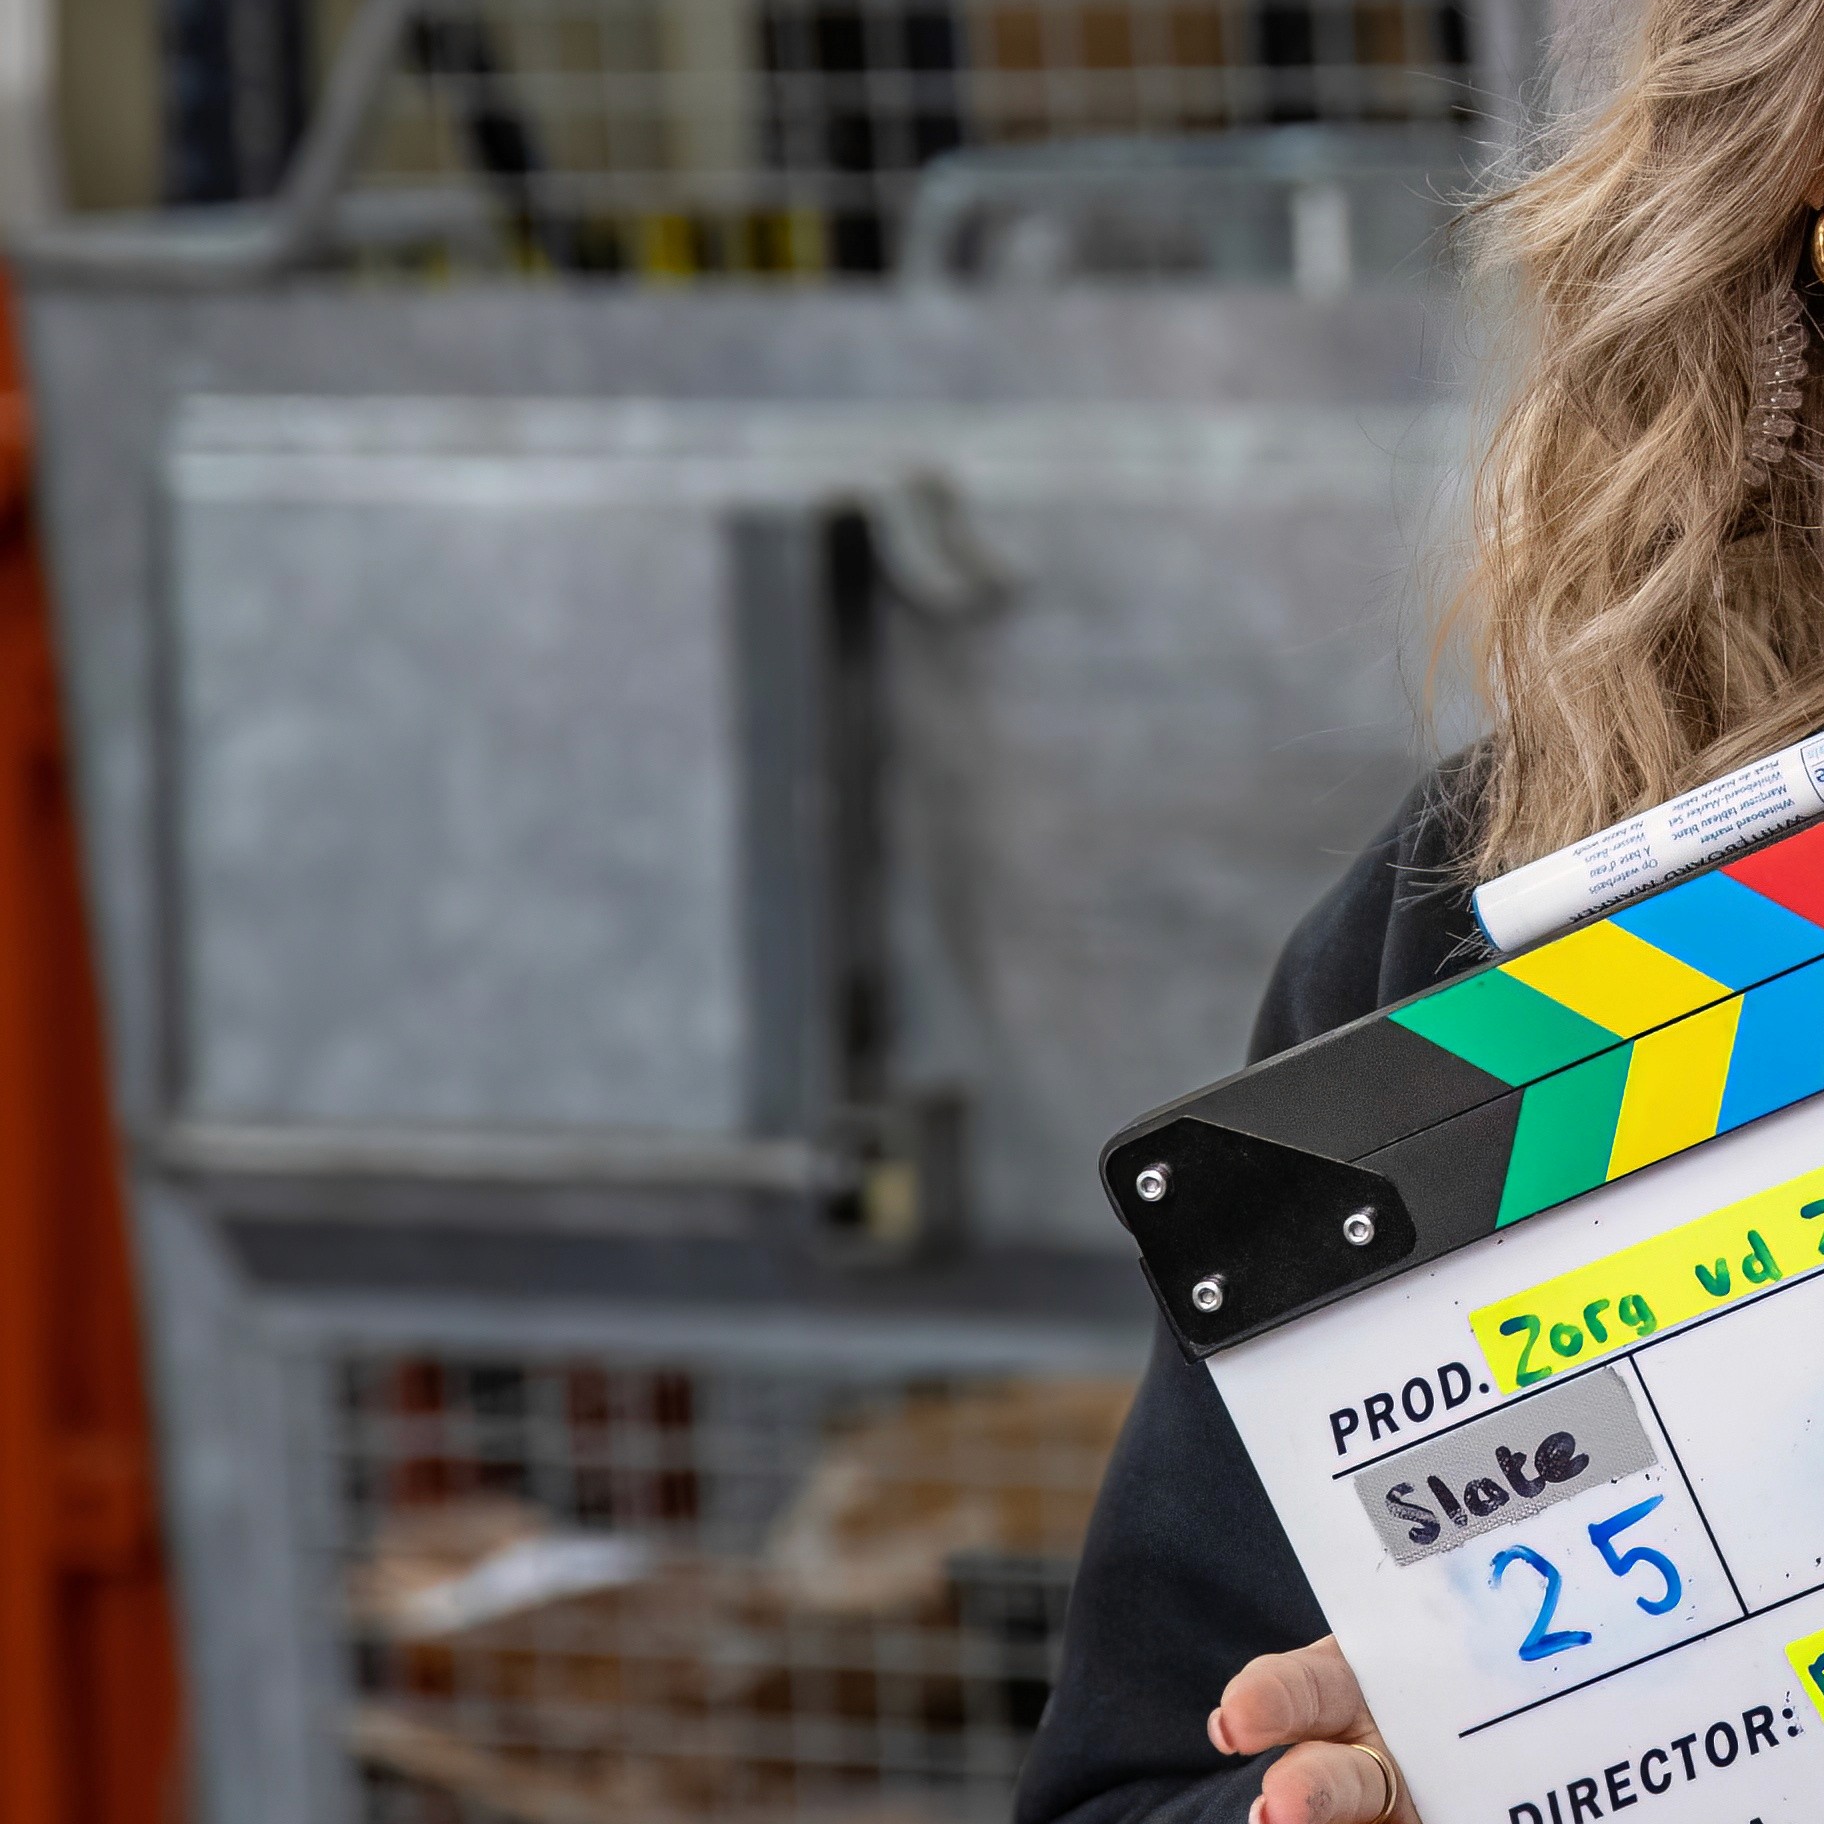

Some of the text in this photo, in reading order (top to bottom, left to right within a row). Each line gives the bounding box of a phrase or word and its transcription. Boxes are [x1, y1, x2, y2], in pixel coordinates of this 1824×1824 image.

[1671, 824, 1700, 843] blanc
[1699, 797, 1795, 845] Whiteboard marker
[1700, 806, 1738, 829] tableau
[1588, 857, 1659, 896] Op waterbasis
[1619, 849, 1642, 867] base
[1499, 1289, 1658, 1387] Zorg
[1694, 1230, 1782, 1298] vd
[1329, 1360, 1490, 1456] PROD.
[1385, 1430, 1591, 1545] Slate
[1489, 1494, 1683, 1662] 25
